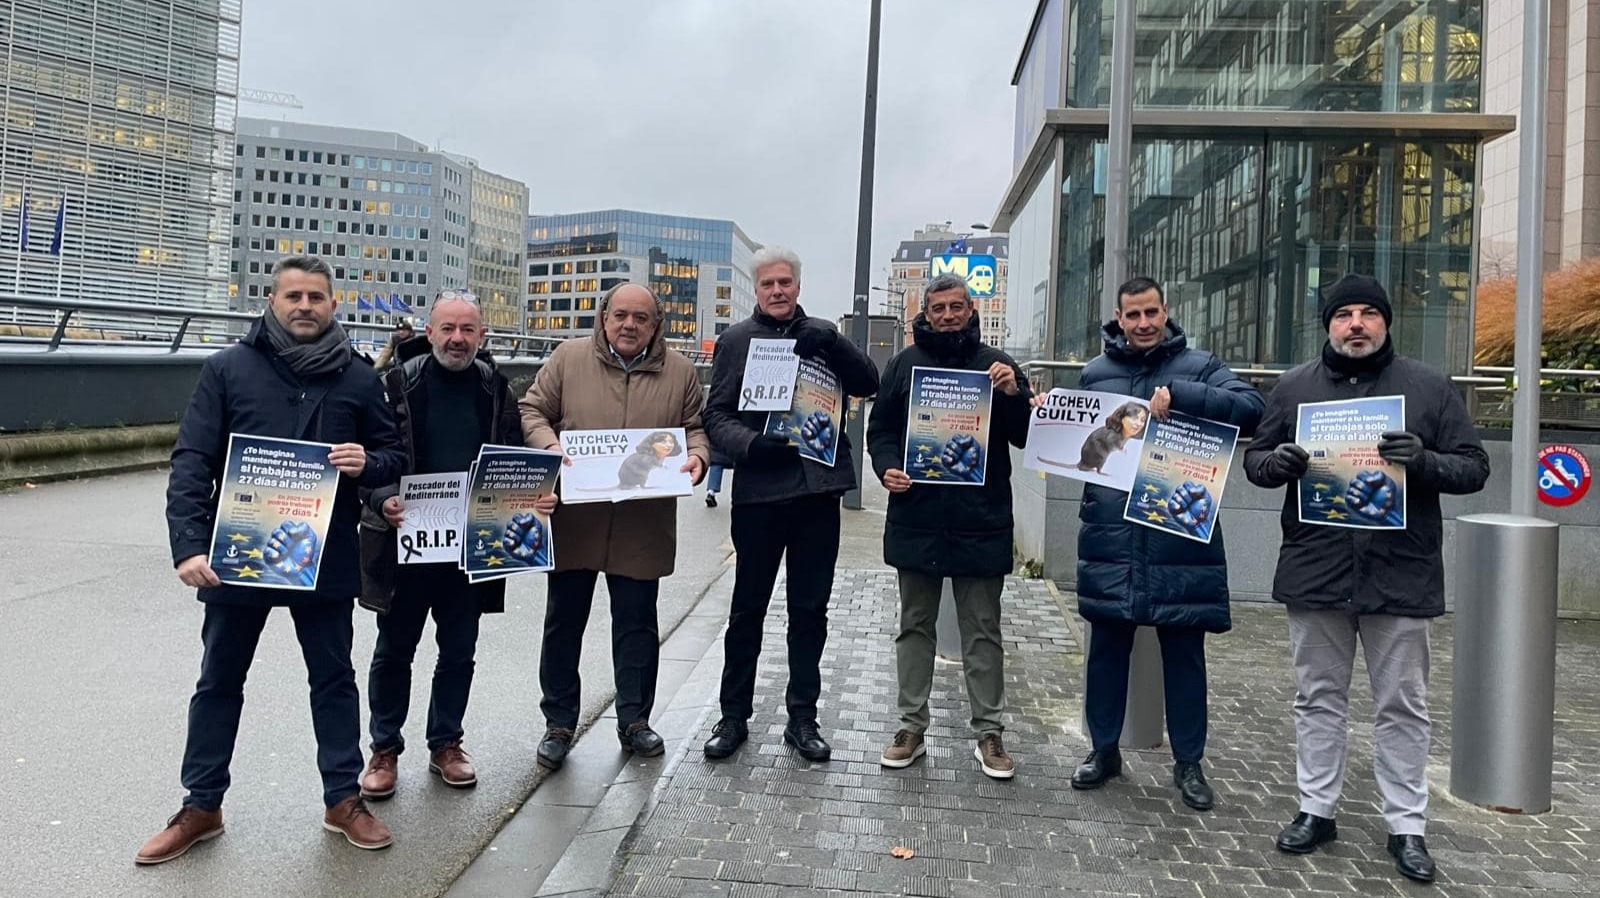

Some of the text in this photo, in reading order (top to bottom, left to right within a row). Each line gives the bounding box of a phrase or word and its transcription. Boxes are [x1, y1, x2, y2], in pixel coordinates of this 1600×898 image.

[933, 256, 969, 278] M
[755, 345, 786, 353] Pescador
[751, 353, 796, 362] Mediterráneo
[754, 385, 788, 400] R.I.P.
[928, 391, 961, 400] trabajas
[930, 400, 947, 408] días
[1045, 394, 1101, 410] ITCHEVA
[1036, 406, 1100, 424] GUILTY
[1320, 422, 1363, 433] trabajas
[1365, 422, 1388, 430] solo
[566, 434, 628, 444] VITCHEVA
[1164, 432, 1200, 446] trabajas
[1324, 432, 1346, 441] días
[1347, 433, 1357, 441] al
[566, 444, 628, 456] GUILTY
[1154, 438, 1165, 447] 27
[1165, 441, 1184, 452] días
[243, 446, 296, 458] ¿Te imaginas
[242, 456, 282, 465] mantener
[298, 461, 325, 470] familia
[240, 464, 322, 480] si trabajas solo
[492, 474, 526, 482] trabajas
[238, 476, 318, 491] 27 días al año?
[408, 480, 460, 491] Pescador del
[404, 490, 460, 501] Mediterráneo
[292, 509, 312, 517] días
[416, 529, 459, 548] R.I.P.
